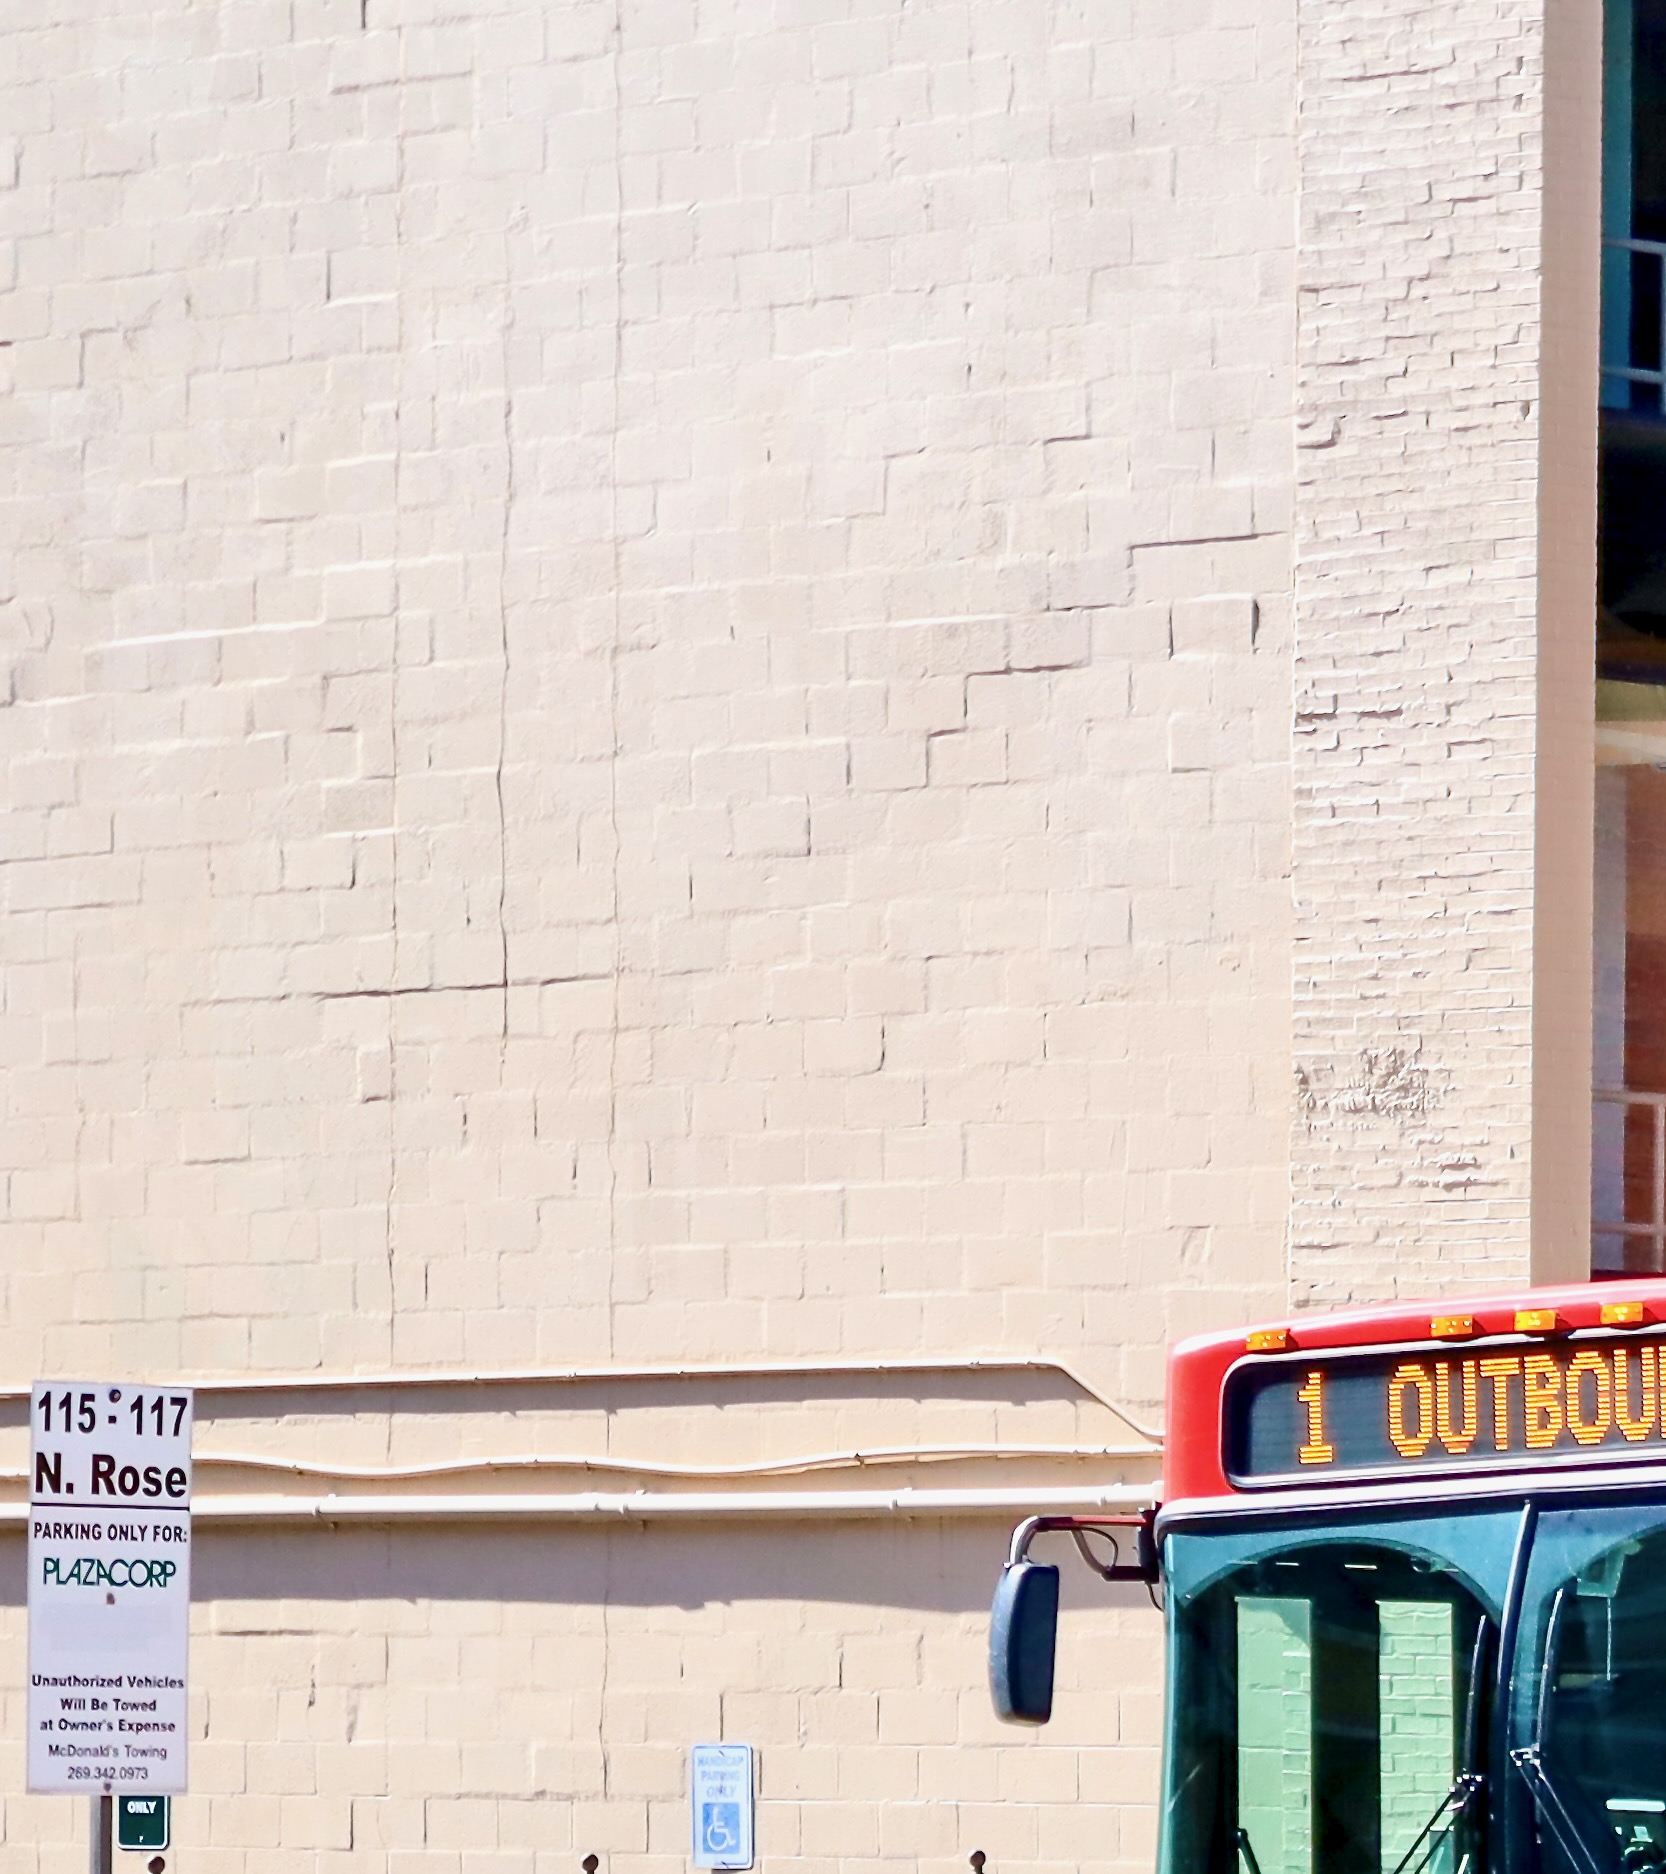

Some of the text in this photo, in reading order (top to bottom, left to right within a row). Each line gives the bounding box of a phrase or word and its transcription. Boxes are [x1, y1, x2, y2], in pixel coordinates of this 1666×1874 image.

[1297, 1371, 1334, 1465] 1
[35, 1451, 187, 1497] N. Rose
[34, 1521, 187, 1543] PARKING ONLY FOR:
[43, 1557, 177, 1588] PLAZACORP
[31, 1674, 184, 1689] Unauthorized Vehicles
[60, 1698, 157, 1712] Will Be Towed
[39, 1718, 176, 1735] at Owner's Expense
[48, 1744, 168, 1761] McDonald's Towing
[127, 1800, 157, 1814] ONLY
